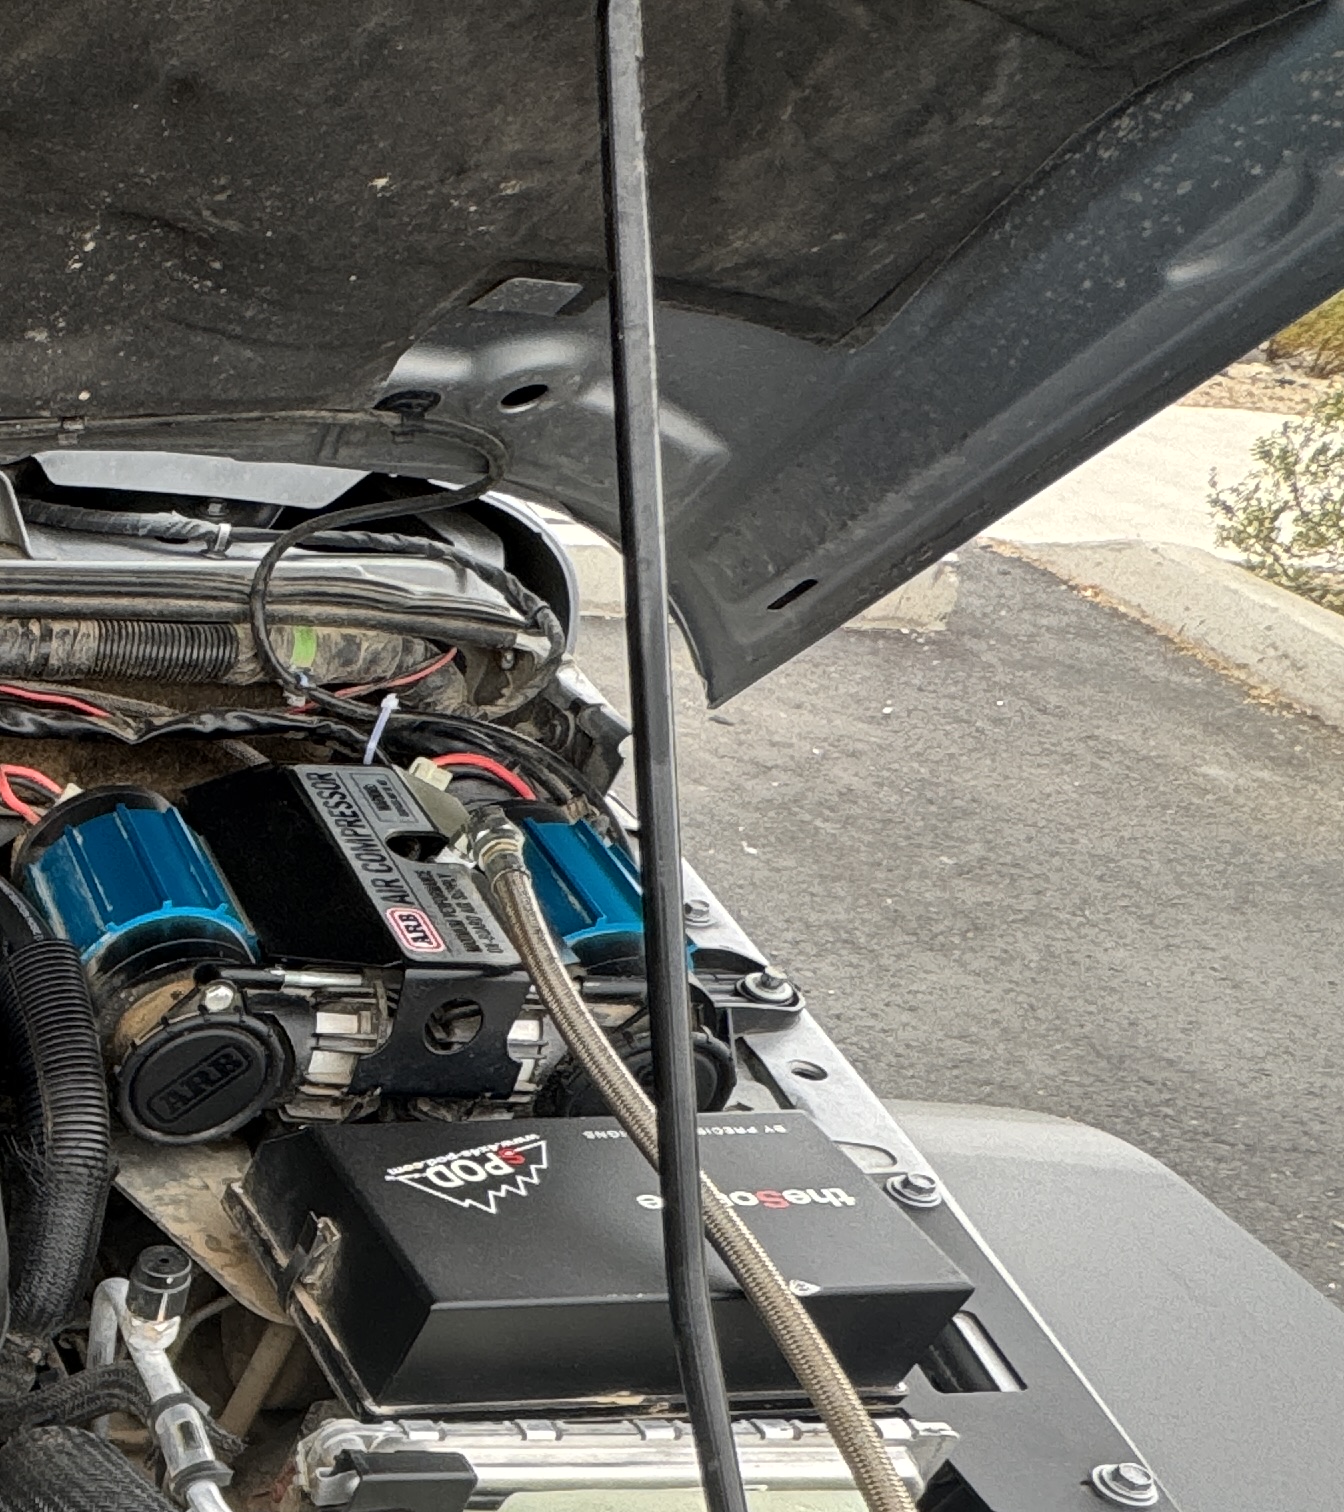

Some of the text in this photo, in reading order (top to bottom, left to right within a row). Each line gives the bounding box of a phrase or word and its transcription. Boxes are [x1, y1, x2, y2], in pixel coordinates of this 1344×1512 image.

[307, 771, 394, 874] COMPRESSOR
[370, 877, 415, 905] AIR
[397, 912, 434, 947] ARB
[159, 1052, 243, 1115] ARB
[636, 1187, 856, 1210] theSoe
